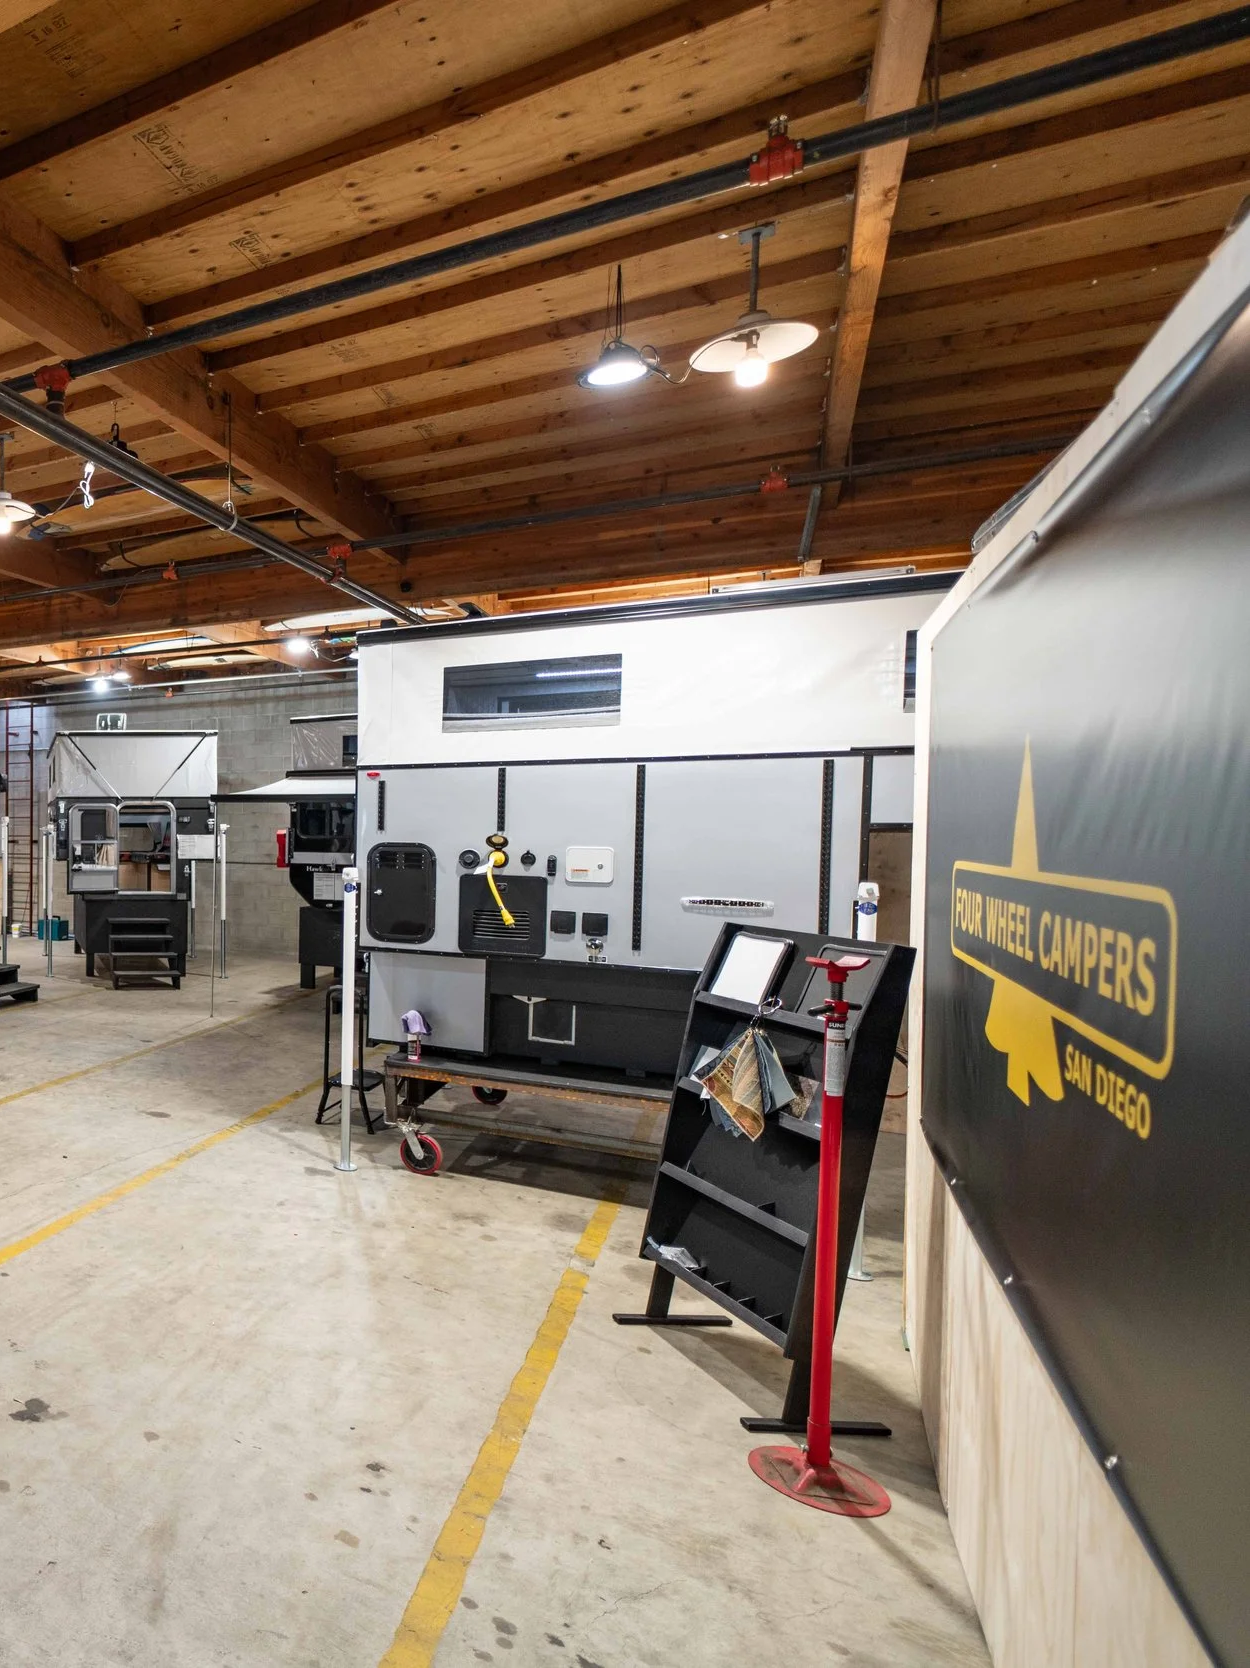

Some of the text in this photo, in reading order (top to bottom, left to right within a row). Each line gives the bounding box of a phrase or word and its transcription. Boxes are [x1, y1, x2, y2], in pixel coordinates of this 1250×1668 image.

[955, 888, 1157, 1016] FOUR WHEEL CAMPERS
[1064, 1044, 1151, 1140] SAN DIEGO
